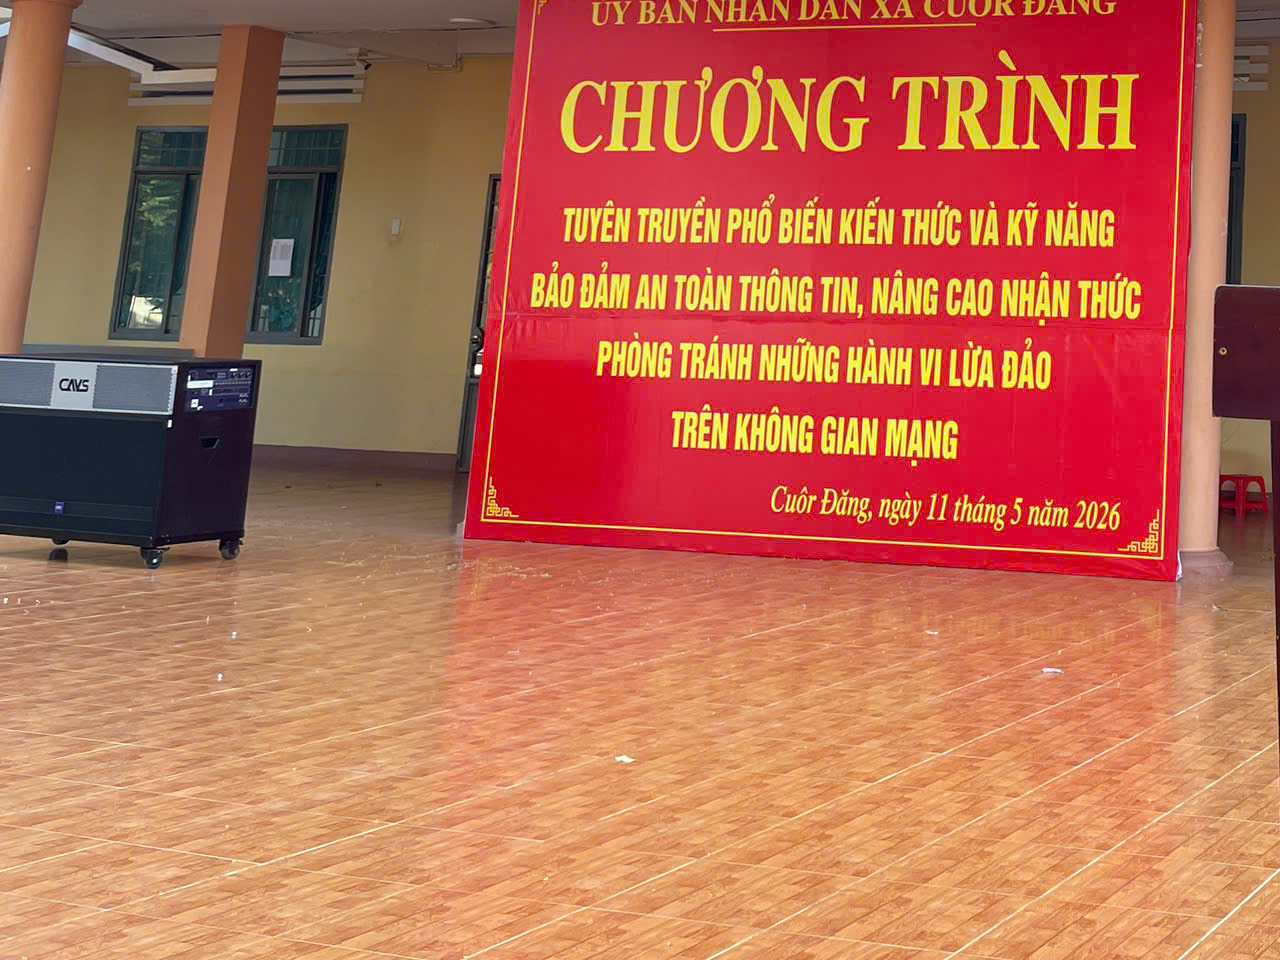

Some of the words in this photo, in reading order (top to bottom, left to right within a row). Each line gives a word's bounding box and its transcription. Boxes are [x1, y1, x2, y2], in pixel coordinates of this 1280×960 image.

[637, 0, 699, 25] BAN
[560, 65, 870, 154] CHƯƠNG
[891, 50, 1140, 151] TRÌNH
[563, 200, 630, 244] TUYÊN
[637, 196, 721, 244] TRUYỀN
[726, 193, 775, 244] PHỔ
[778, 196, 833, 244] BIẾN
[838, 196, 894, 245] KIẾN
[902, 200, 961, 246] THỨC
[969, 201, 999, 246] VÀ
[1006, 202, 1039, 247] KỸ
[1045, 201, 1115, 247] NĂNG
[530, 261, 574, 309] BẢO
[579, 261, 631, 309] ĐẢM
[635, 274, 668, 310] AN
[675, 267, 732, 311] TOÀN
[739, 268, 813, 313] THÔNG
[820, 277, 863, 318] TIN,
[871, 269, 938, 315] NÂNG
[946, 278, 993, 317] CAO
[1000, 272, 1070, 326] NHẬN
[1078, 273, 1141, 319] THỨC
[596, 332, 672, 378] PHÒNG
[679, 335, 753, 380] TRÁNH
[758, 338, 840, 383] NHỮNG
[846, 338, 912, 385] HÀNH
[920, 348, 942, 386] VI
[949, 341, 994, 388] LỪA
[1001, 337, 1052, 390] ĐẢO
[672, 404, 729, 450] TRÊN
[734, 406, 814, 453] KHÔNG
[821, 416, 878, 456] GIAN
[885, 418, 958, 467] MẠNG
[770, 485, 817, 513] Cuôr
[820, 488, 873, 524] Đăng,
[878, 491, 922, 527] ngày
[927, 493, 949, 521] 11
[953, 494, 1007, 531] tháng
[1010, 497, 1023, 525] 5
[1027, 498, 1069, 528] năm
[1073, 500, 1121, 530] 2026
